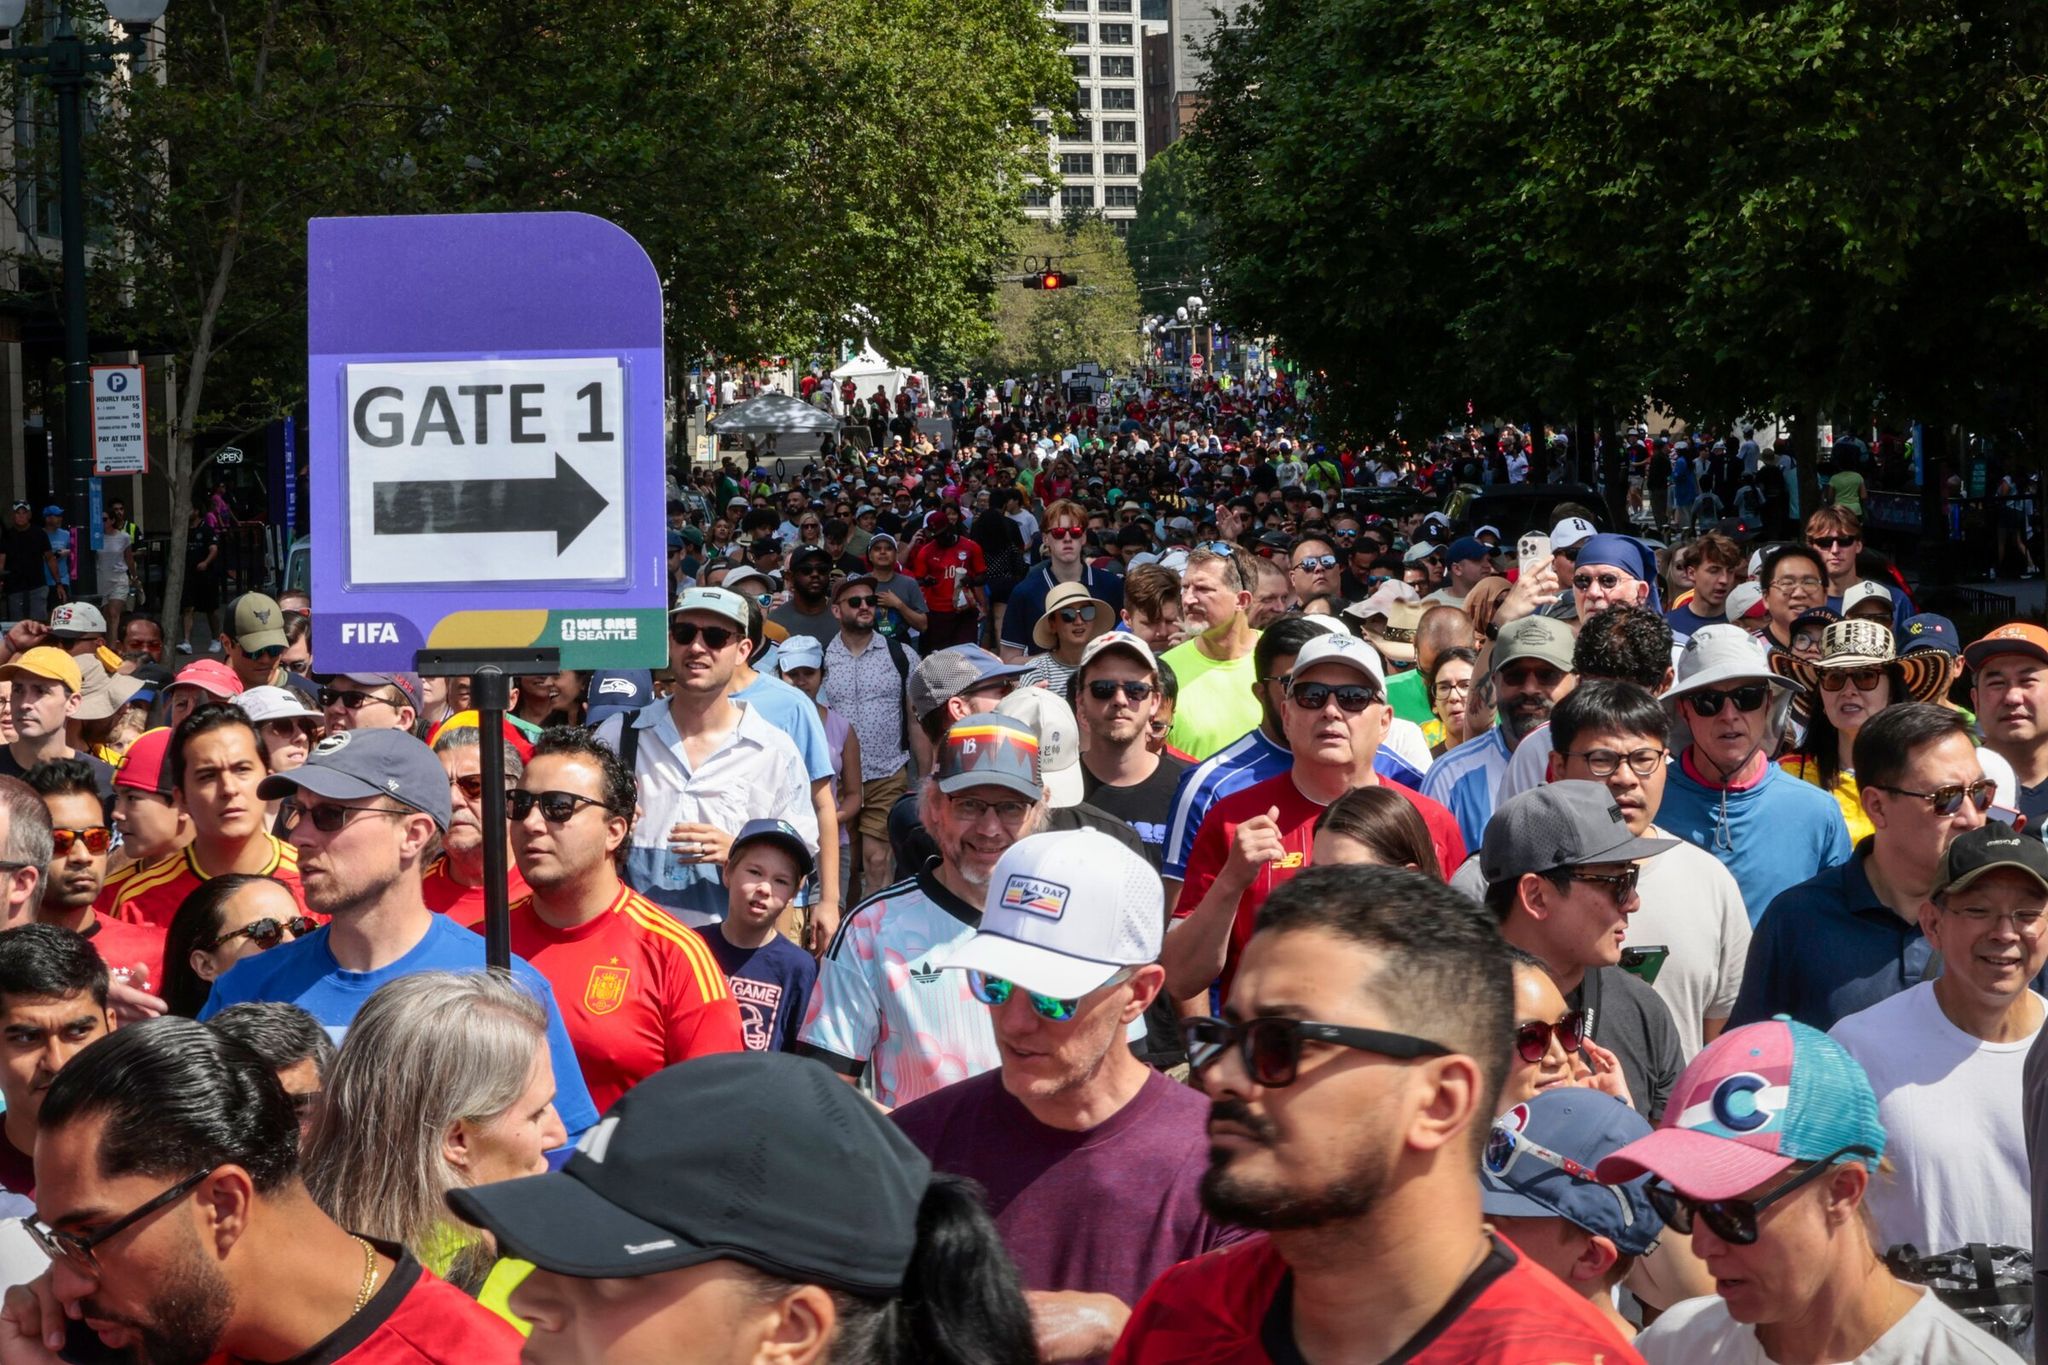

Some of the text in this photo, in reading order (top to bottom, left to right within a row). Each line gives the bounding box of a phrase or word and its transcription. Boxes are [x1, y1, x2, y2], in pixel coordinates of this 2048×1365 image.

[112, 375, 124, 390] P
[353, 382, 614, 447] GATE 1
[944, 565, 956, 579] 10
[577, 618, 602, 630] WE
[341, 622, 399, 644] FIFA
[577, 630, 637, 641] SEATTLE
[1010, 880, 1065, 898] HAVE A DAY
[732, 981, 778, 1003] GAME
